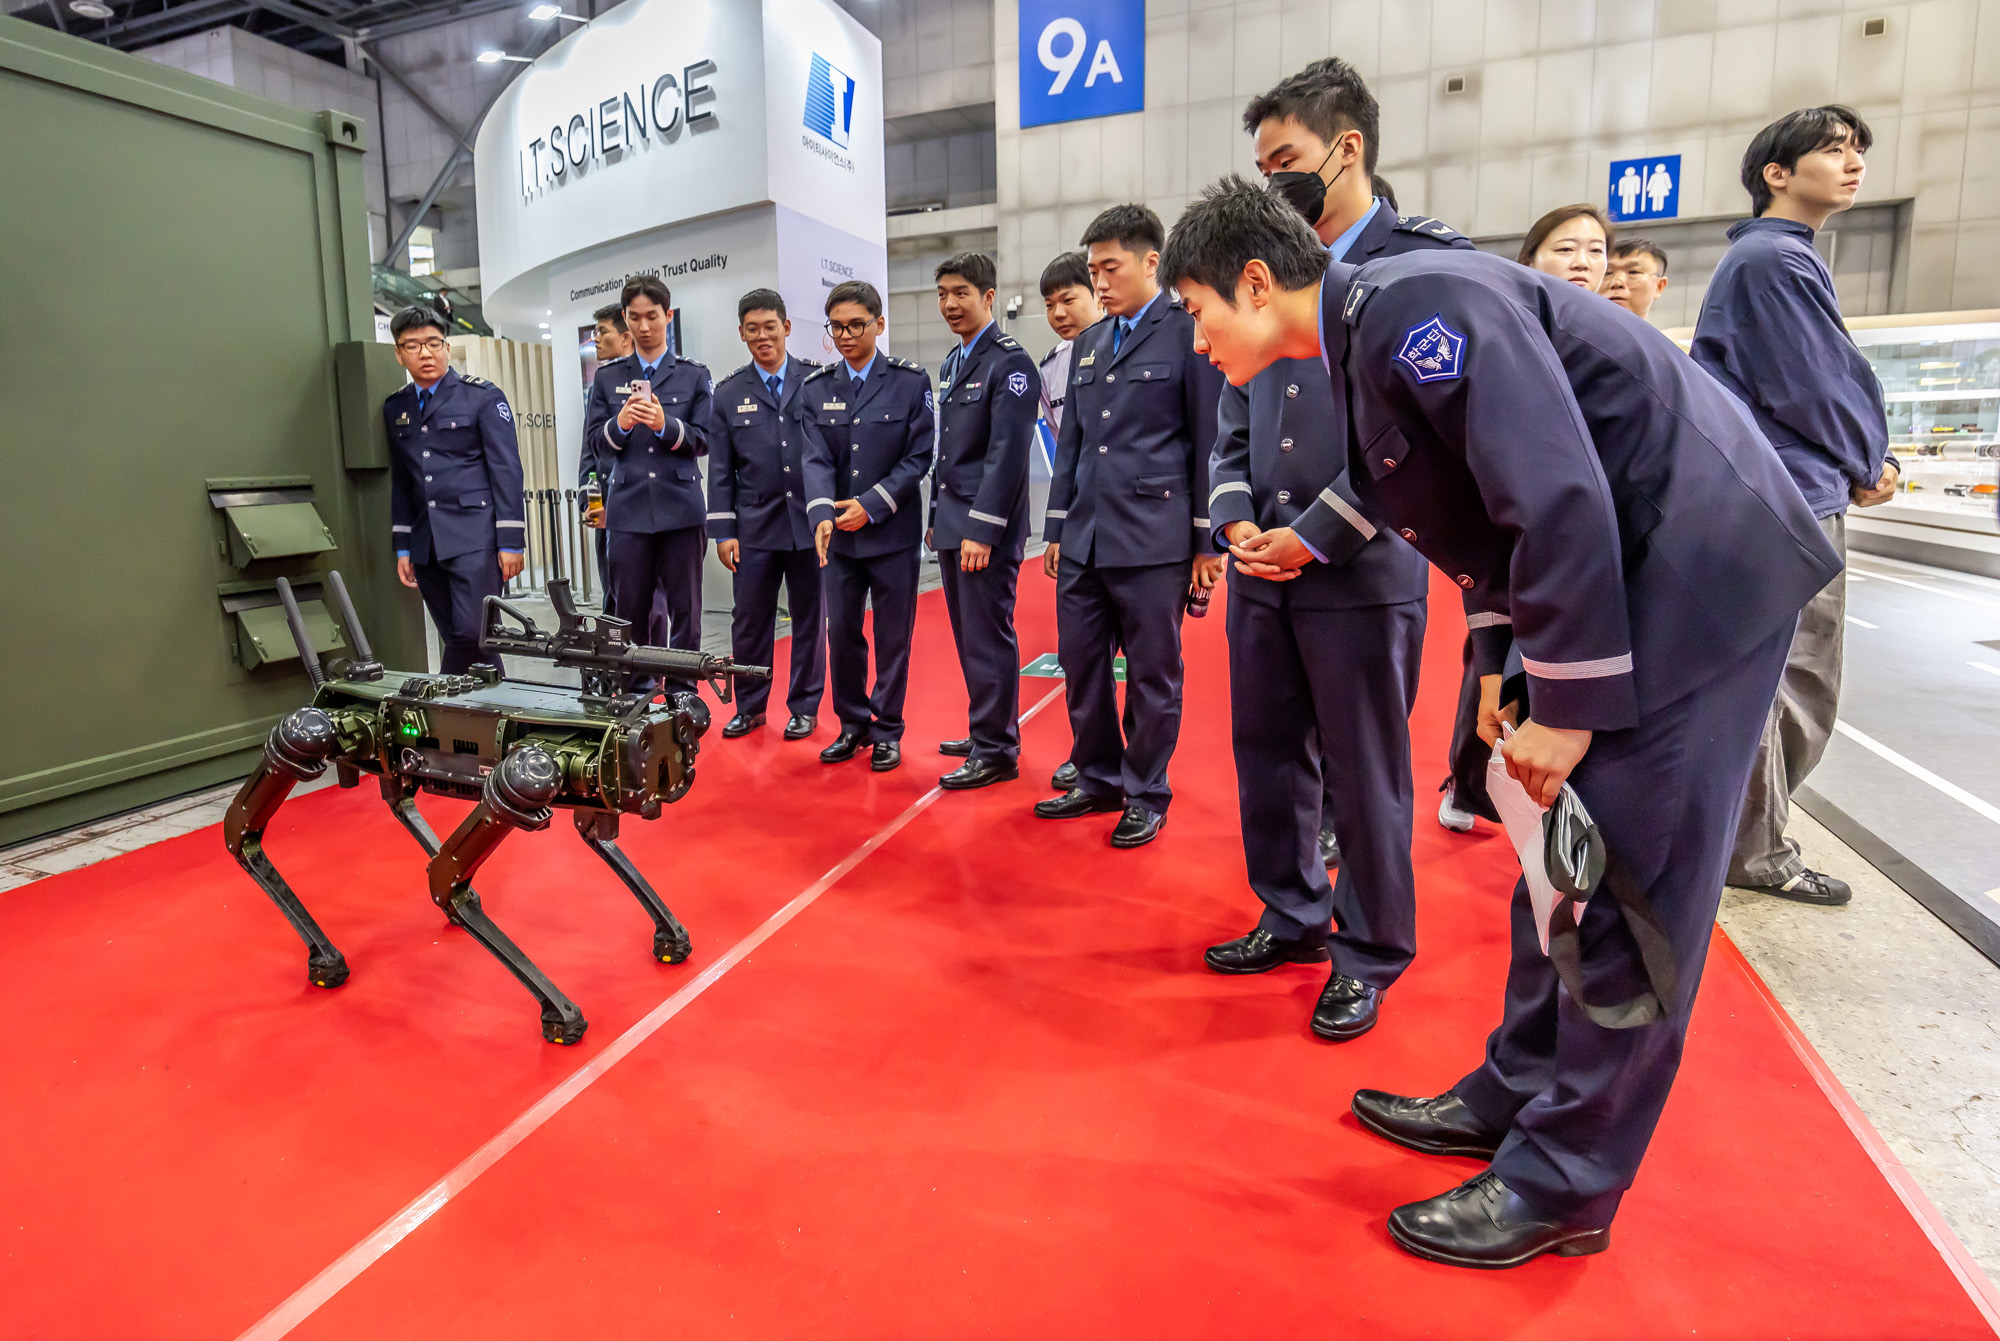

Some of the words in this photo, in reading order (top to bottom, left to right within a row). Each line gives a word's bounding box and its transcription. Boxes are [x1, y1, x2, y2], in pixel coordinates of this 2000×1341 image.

[1037, 16, 1123, 96] 9A
[519, 58, 714, 200] I.T.SCIENCE
[802, 135, 856, 175] 아이티사이언스(주)
[570, 277, 624, 302] Communication
[662, 261, 688, 278] Trust
[690, 254, 728, 272] Quality
[1407, 328, 1442, 361] 학군단
